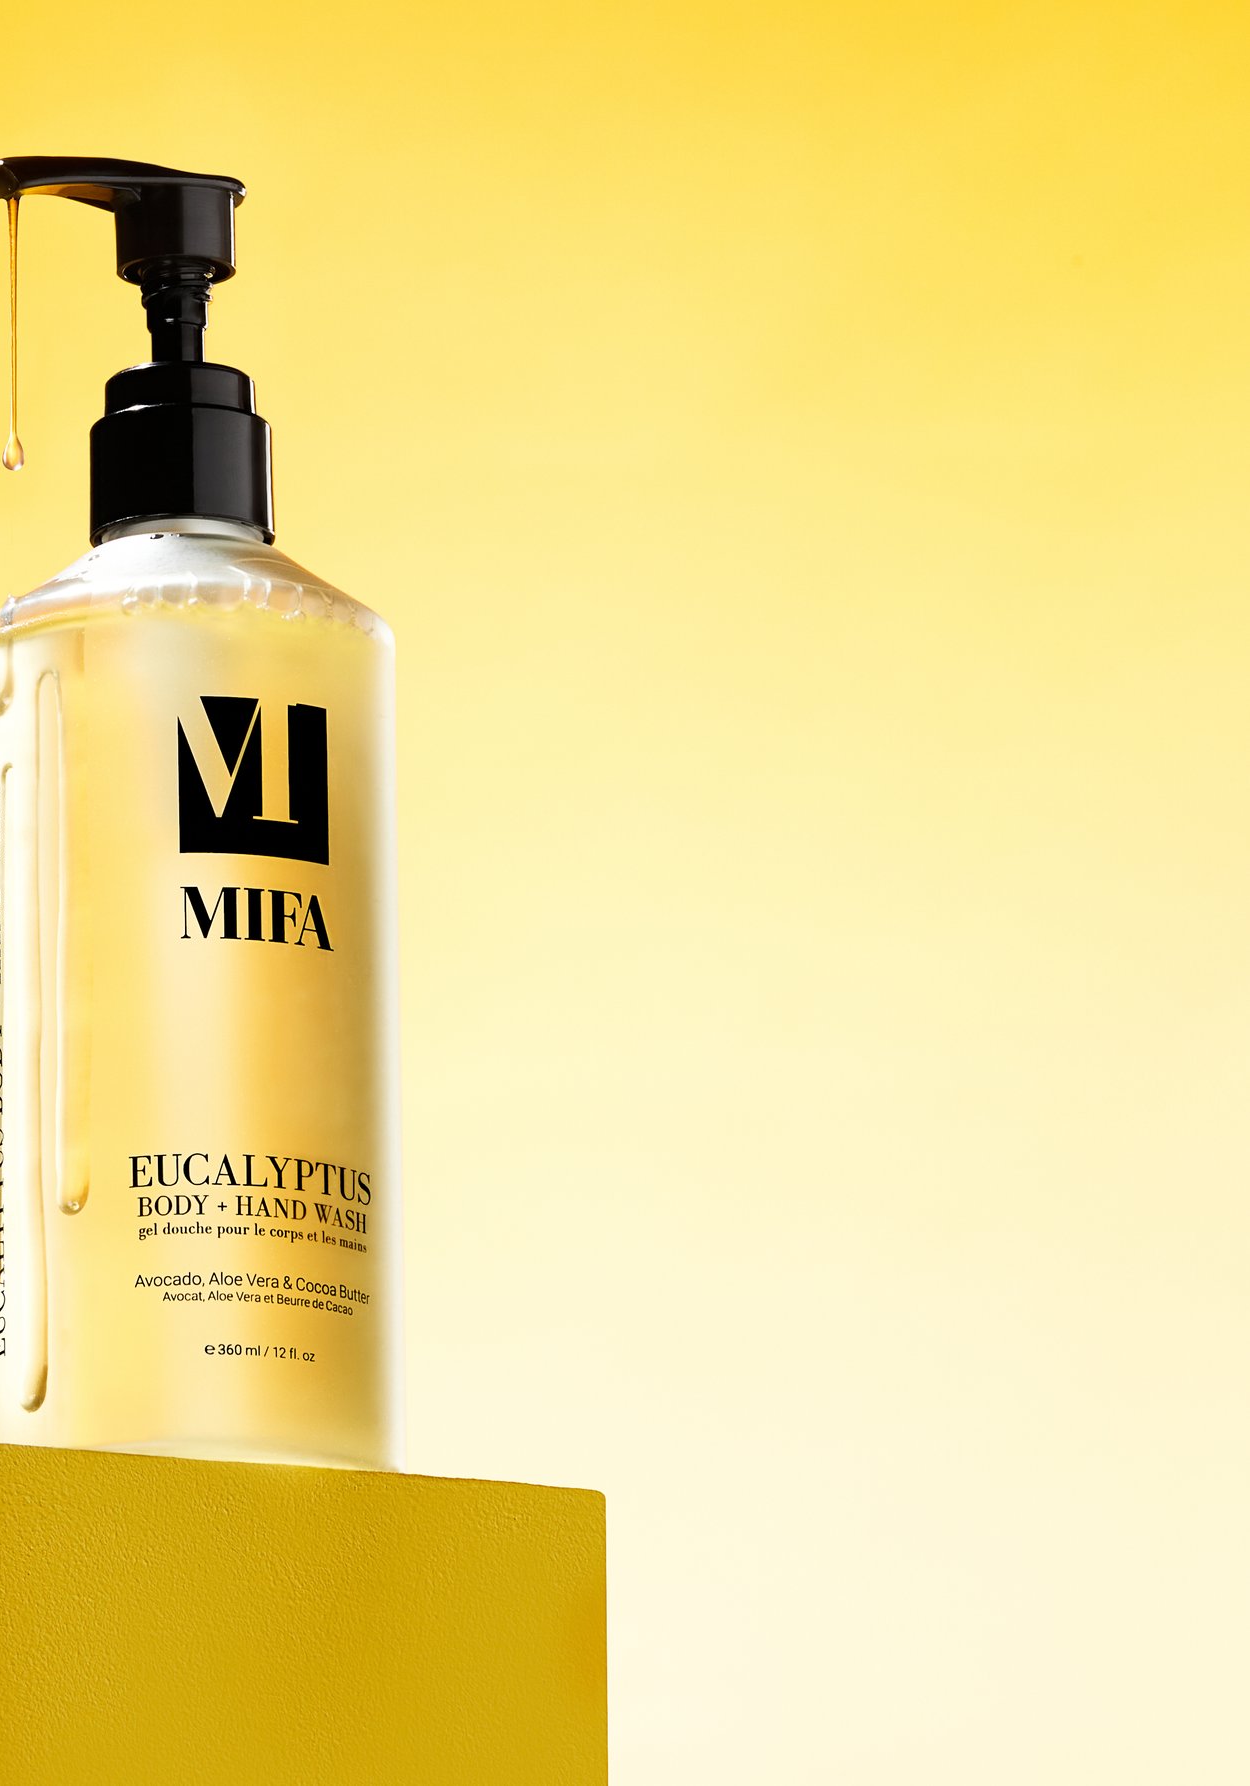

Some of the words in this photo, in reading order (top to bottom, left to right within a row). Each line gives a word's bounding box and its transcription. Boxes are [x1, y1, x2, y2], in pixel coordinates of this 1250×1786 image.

[180, 886, 334, 951] MIFA
[128, 1152, 372, 1206] EUCALYPTUS
[137, 1194, 209, 1218] BODY
[235, 1195, 307, 1221] HAND
[313, 1202, 368, 1234] WASH
[138, 1223, 158, 1240] gel
[162, 1222, 212, 1235] douche
[217, 1223, 250, 1238] pour
[254, 1223, 266, 1236] le
[269, 1226, 304, 1243] corps
[306, 1229, 318, 1242] et
[321, 1230, 337, 1246] les
[339, 1236, 368, 1253] mains
[134, 1271, 206, 1288] Avocado,
[208, 1271, 243, 1286] Aloe
[246, 1273, 279, 1289] Vera
[283, 1275, 293, 1290] &
[296, 1277, 337, 1297] Cocoa
[339, 1284, 370, 1305] Butter
[162, 1291, 206, 1304] Avocat,
[207, 1290, 234, 1302] Aloe
[236, 1291, 261, 1304] Vera
[263, 1293, 274, 1304] et
[277, 1294, 310, 1308] Beurre
[312, 1297, 324, 1310] de
[325, 1300, 354, 1316] Cacao
[217, 1344, 243, 1356] 360
[245, 1345, 261, 1357] ml
[273, 1346, 287, 1359] 12
[289, 1347, 300, 1361] fl.
[302, 1352, 316, 1363] oz
